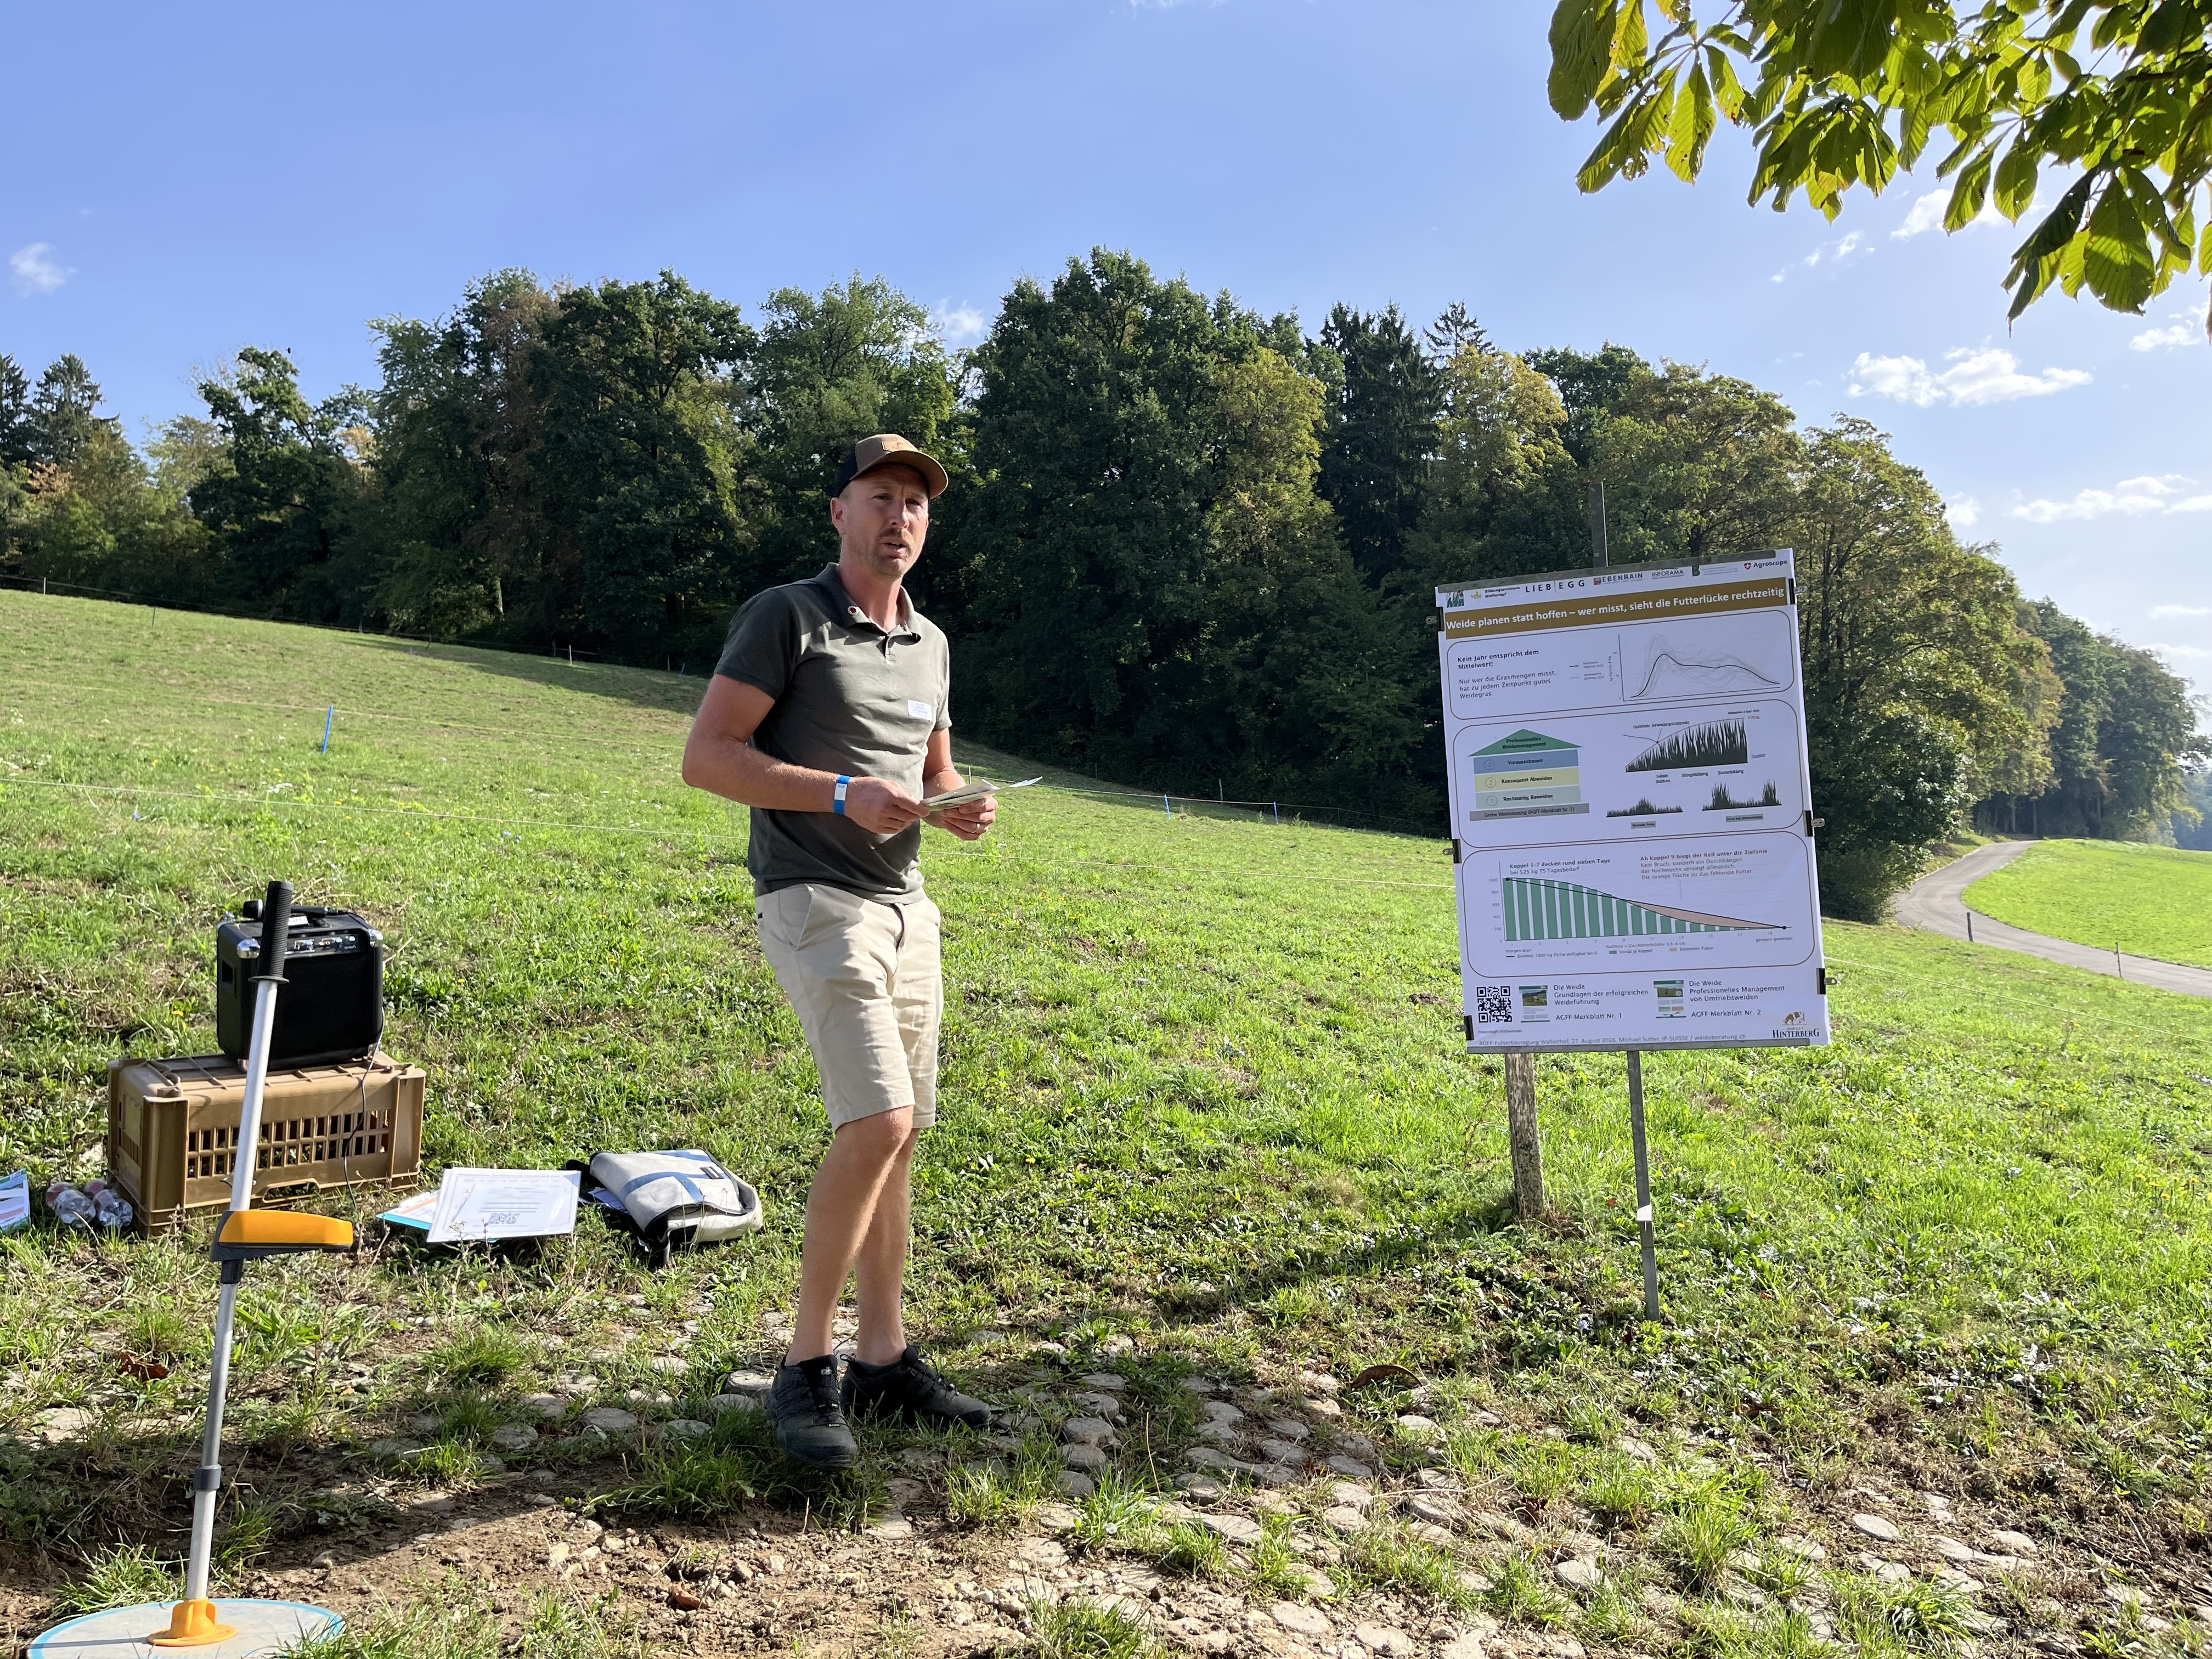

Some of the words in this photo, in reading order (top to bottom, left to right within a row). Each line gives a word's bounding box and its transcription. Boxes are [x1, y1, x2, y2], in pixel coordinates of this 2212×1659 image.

[1753, 560, 1787, 568] Agroscope
[1602, 572, 1643, 582] EBENRAIN
[1651, 569, 1684, 577] INFORAMA
[1525, 583, 1551, 592] LIEB
[1559, 579, 1585, 589] EGG
[1446, 619, 1475, 629] Weide
[1478, 617, 1510, 628] planen
[1512, 613, 1534, 622] statt
[1536, 610, 1567, 620] hoffen
[1598, 603, 1627, 613] misst,
[1629, 601, 1653, 610] sieht
[1655, 599, 1671, 607] die
[1673, 592, 1729, 606] Futterlücke
[1731, 587, 1784, 600] rechtzeitig
[1489, 651, 1522, 659] entspricht
[1458, 661, 1493, 669] Mittelwert!
[1772, 1028, 1819, 1038] HINTERBERG
